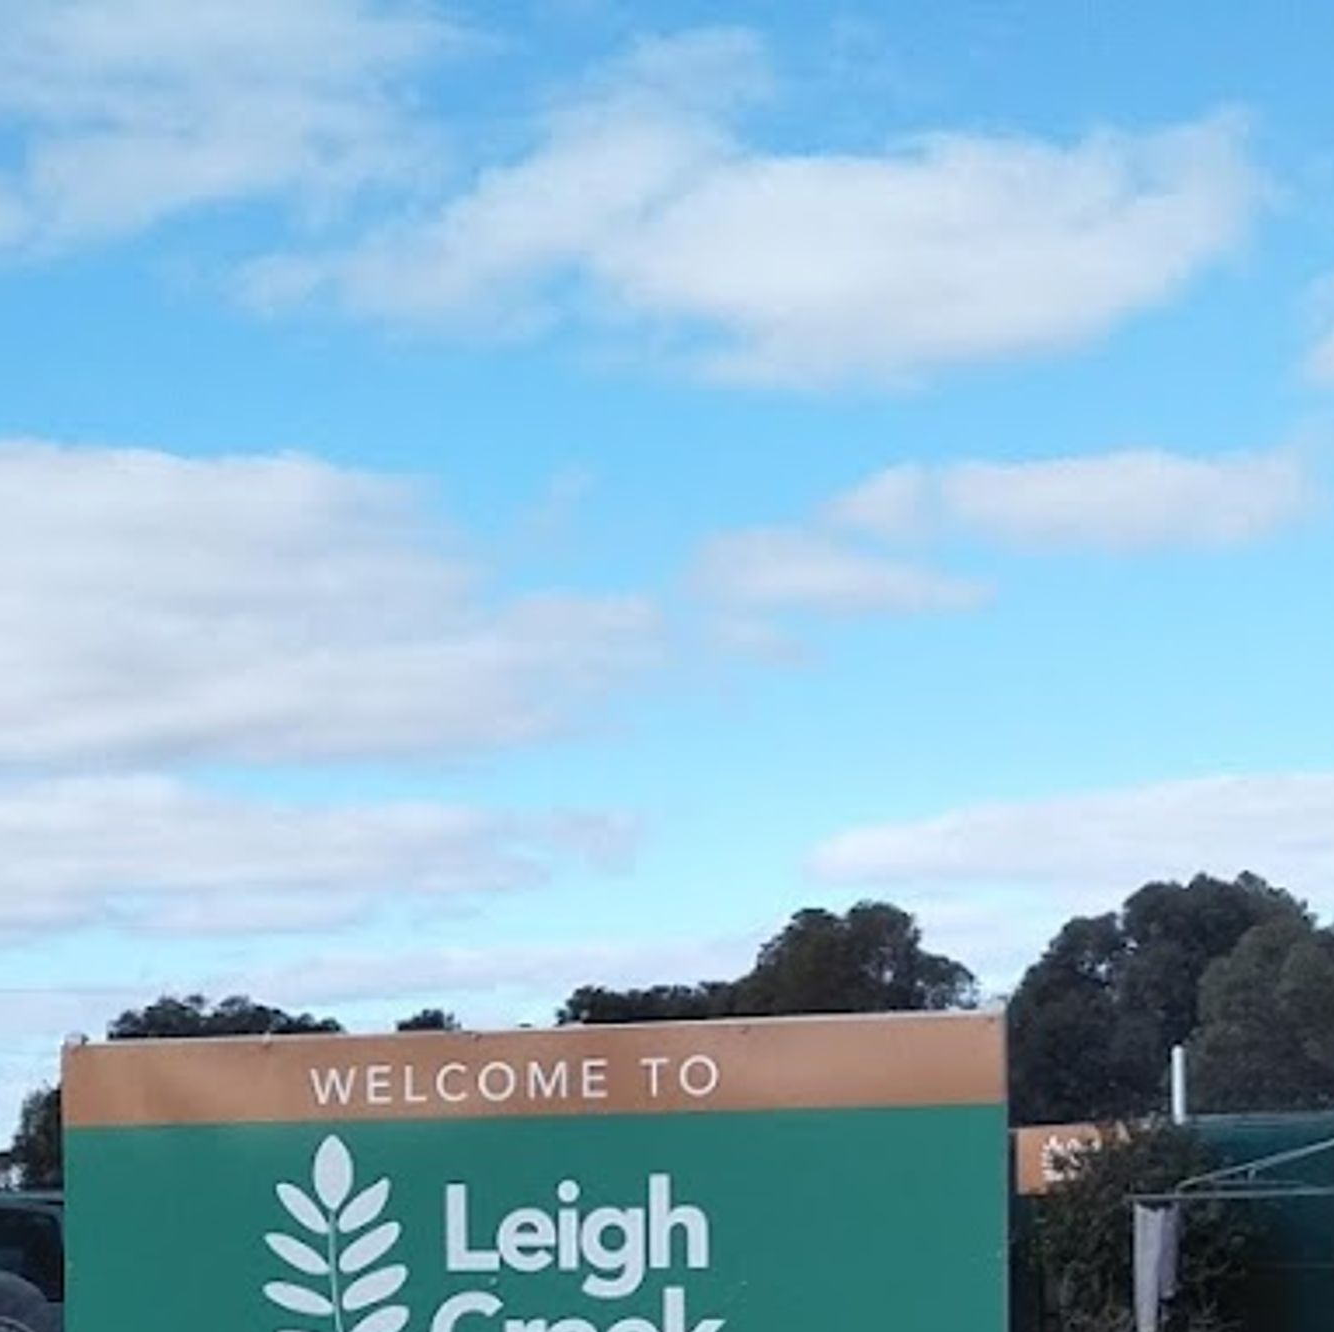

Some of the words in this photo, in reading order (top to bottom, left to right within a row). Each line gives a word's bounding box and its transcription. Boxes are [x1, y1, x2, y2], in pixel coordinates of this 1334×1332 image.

[310, 1059, 607, 1105] WELCOME
[641, 1054, 720, 1096] TO
[445, 1172, 710, 1300] Leigh
